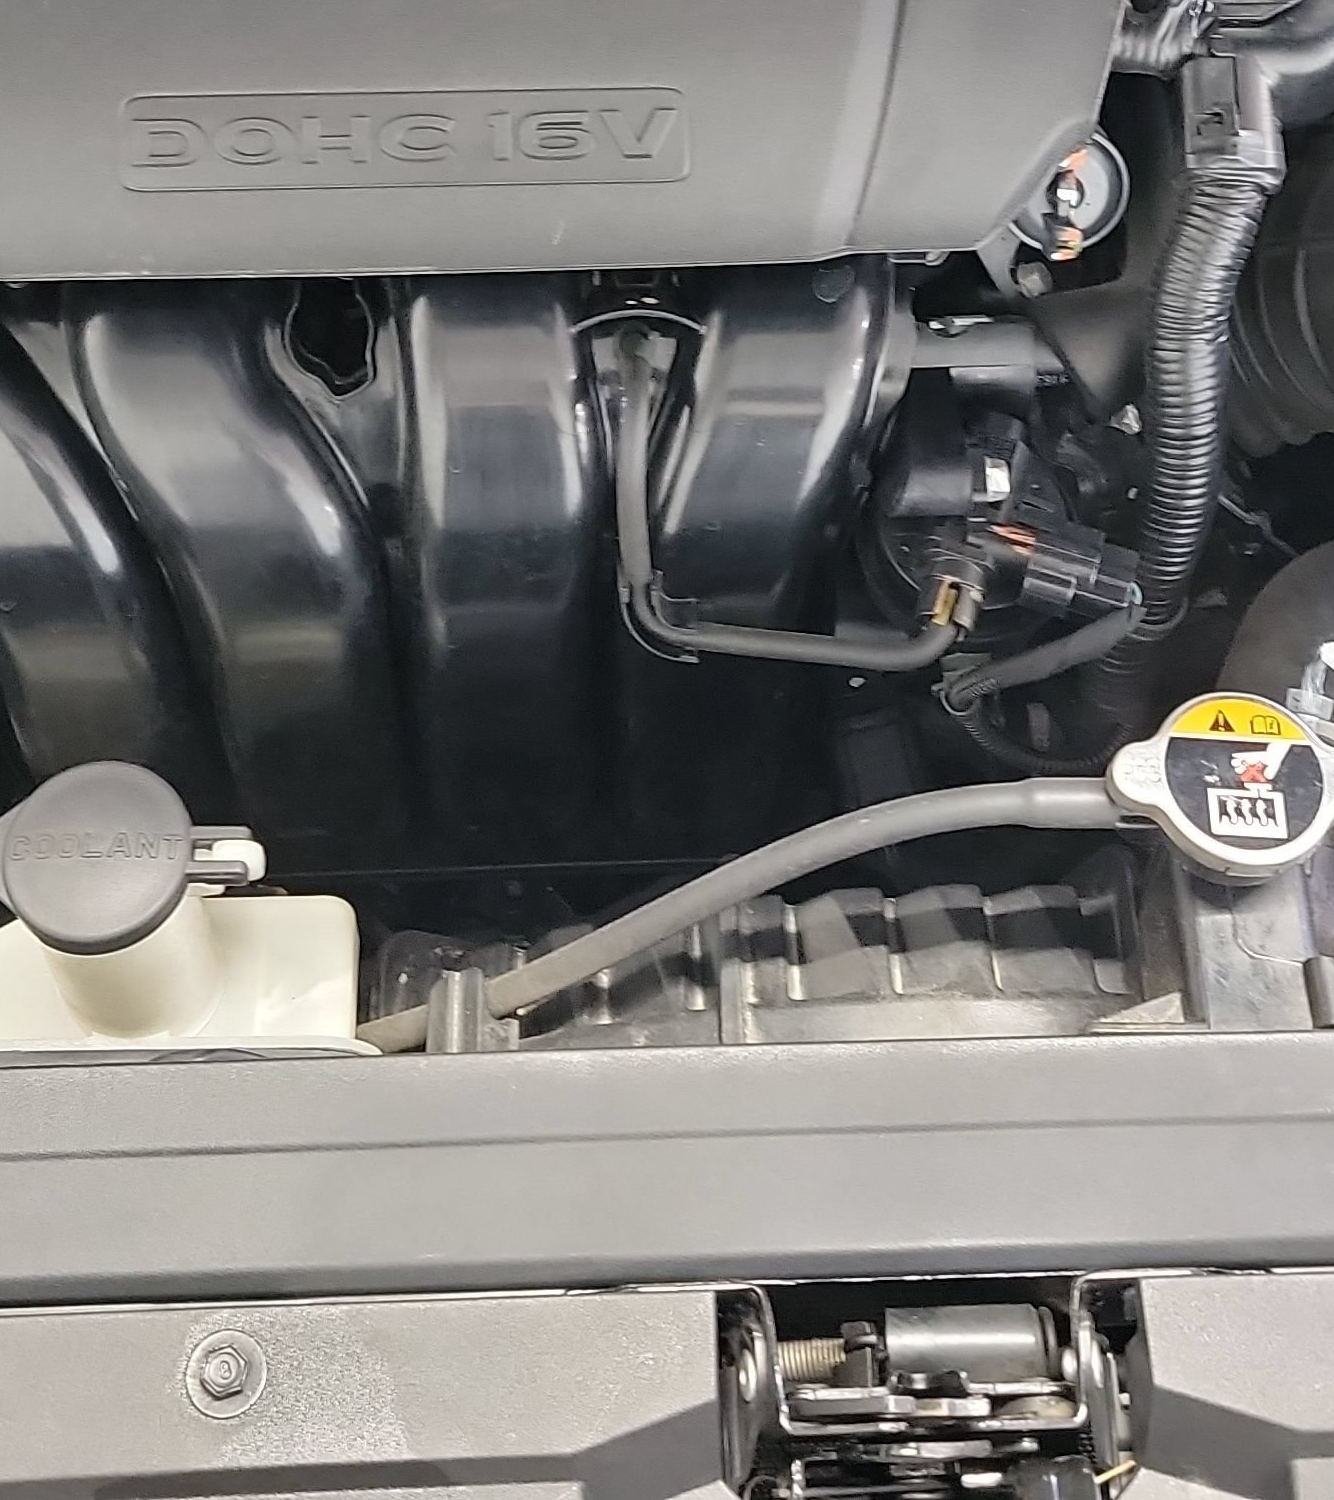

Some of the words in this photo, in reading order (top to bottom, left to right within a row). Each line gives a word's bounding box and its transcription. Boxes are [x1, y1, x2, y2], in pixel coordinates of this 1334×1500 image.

[129, 112, 457, 168] DOHC
[486, 106, 678, 162] 16V
[9, 831, 185, 862] COOLANT
